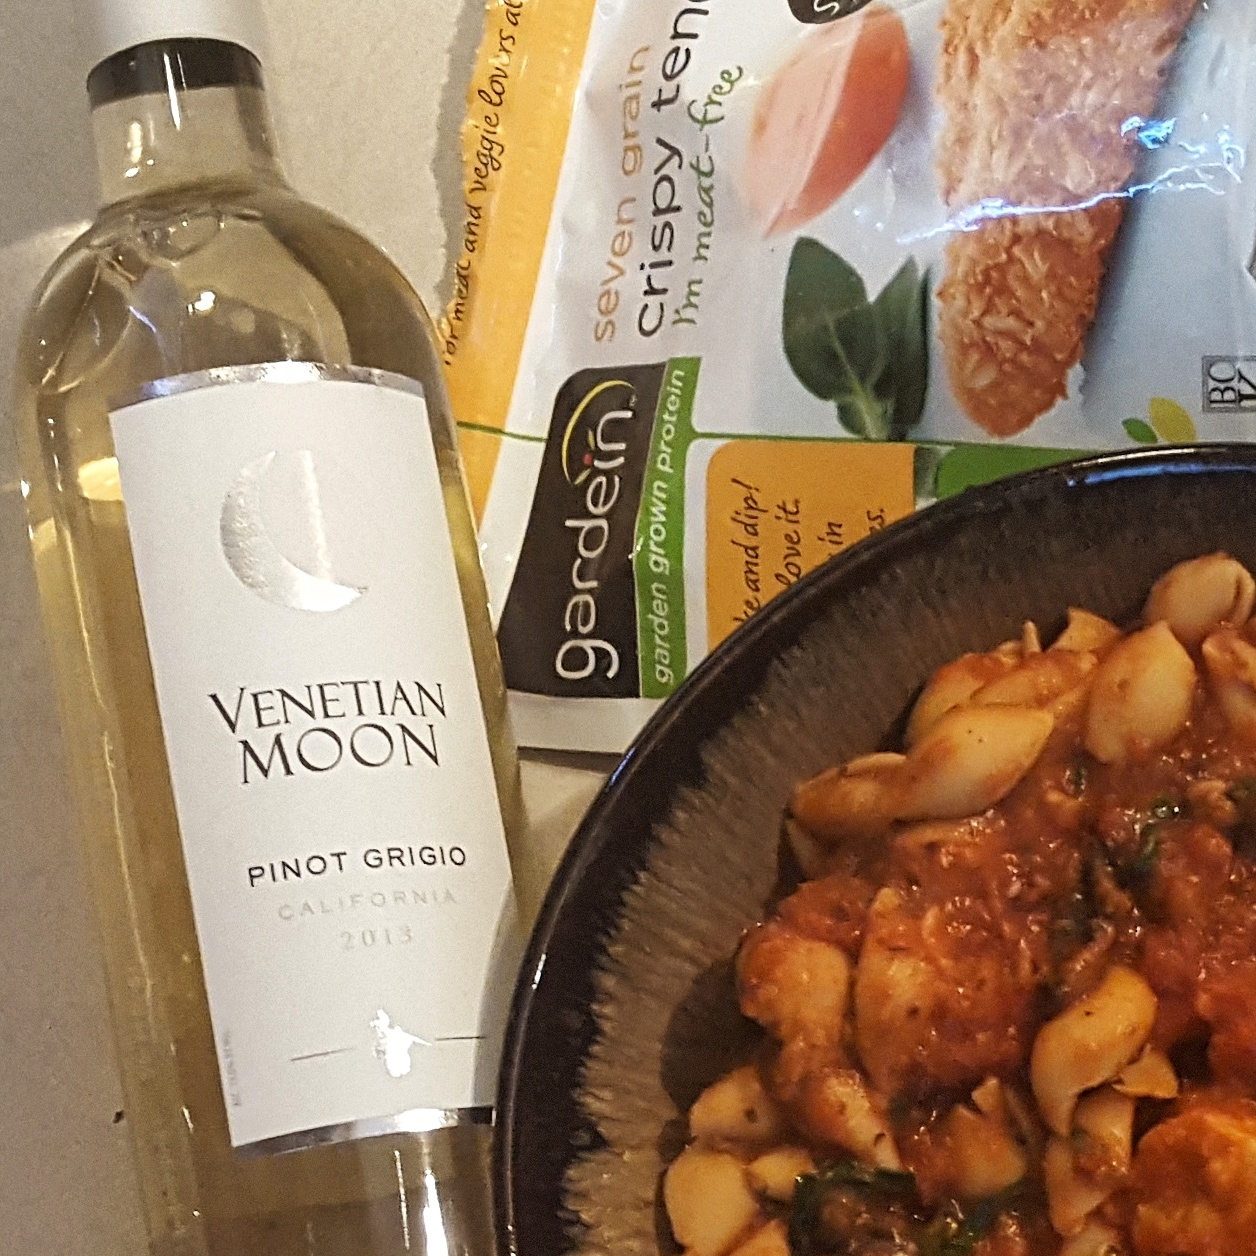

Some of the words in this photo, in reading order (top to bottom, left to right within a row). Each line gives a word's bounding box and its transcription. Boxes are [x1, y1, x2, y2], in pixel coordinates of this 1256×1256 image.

[650, 0, 710, 112] ten
[469, 112, 505, 194] veggie
[594, 196, 637, 342] seven
[618, 44, 652, 176] grain
[464, 201, 483, 254] and
[655, 368, 687, 473] protein
[639, 479, 671, 575] grown
[730, 477, 769, 538] dip!
[816, 521, 844, 546] in
[554, 408, 635, 682] gardein
[730, 539, 761, 593] and
[774, 529, 802, 587] love
[651, 579, 675, 684] garden
[207, 679, 447, 735] VENETIAN
[239, 722, 441, 785] MOON
[247, 851, 348, 888] PINOT
[363, 845, 468, 870] GRIGIO
[278, 888, 459, 922] CALIFORNIA
[340, 925, 415, 953] 2013
